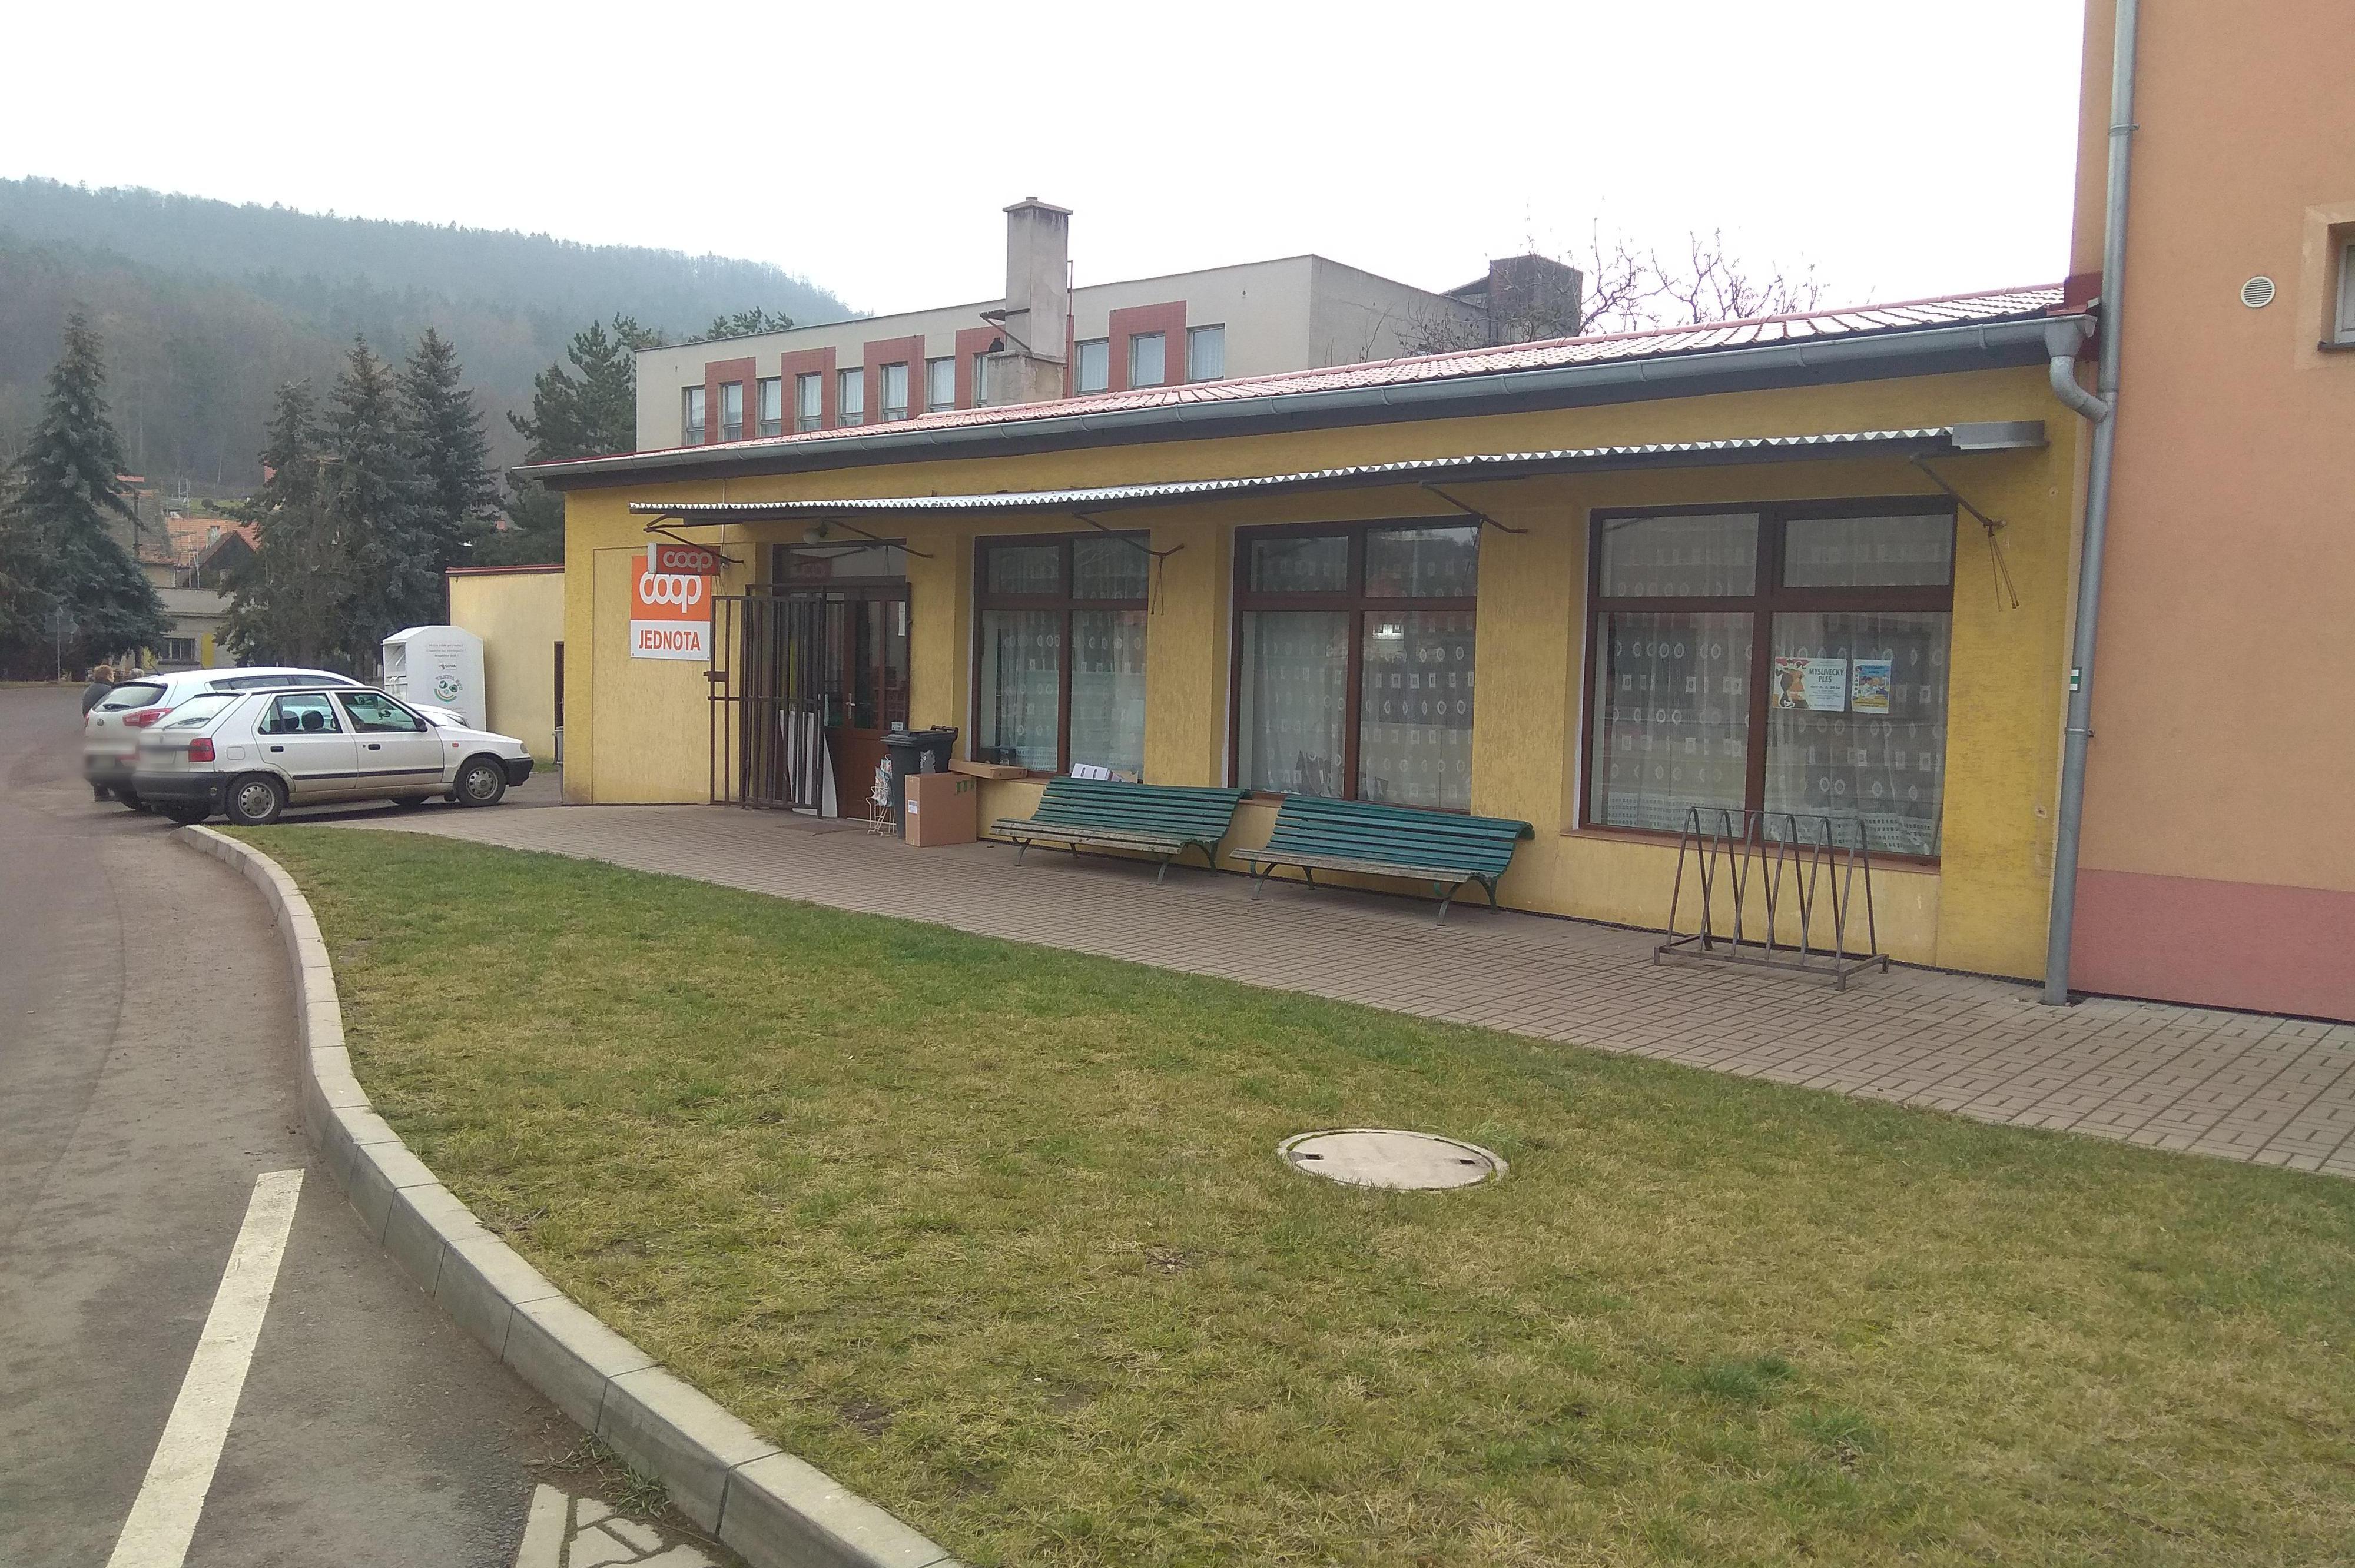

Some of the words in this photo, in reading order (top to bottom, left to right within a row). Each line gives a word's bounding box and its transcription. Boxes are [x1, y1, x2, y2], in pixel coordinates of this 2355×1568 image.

[663, 551, 712, 573] coop
[639, 571, 702, 613] coop
[639, 630, 701, 651] JEDNOTA
[1808, 667, 1845, 676] MYSLIVECKÝ
